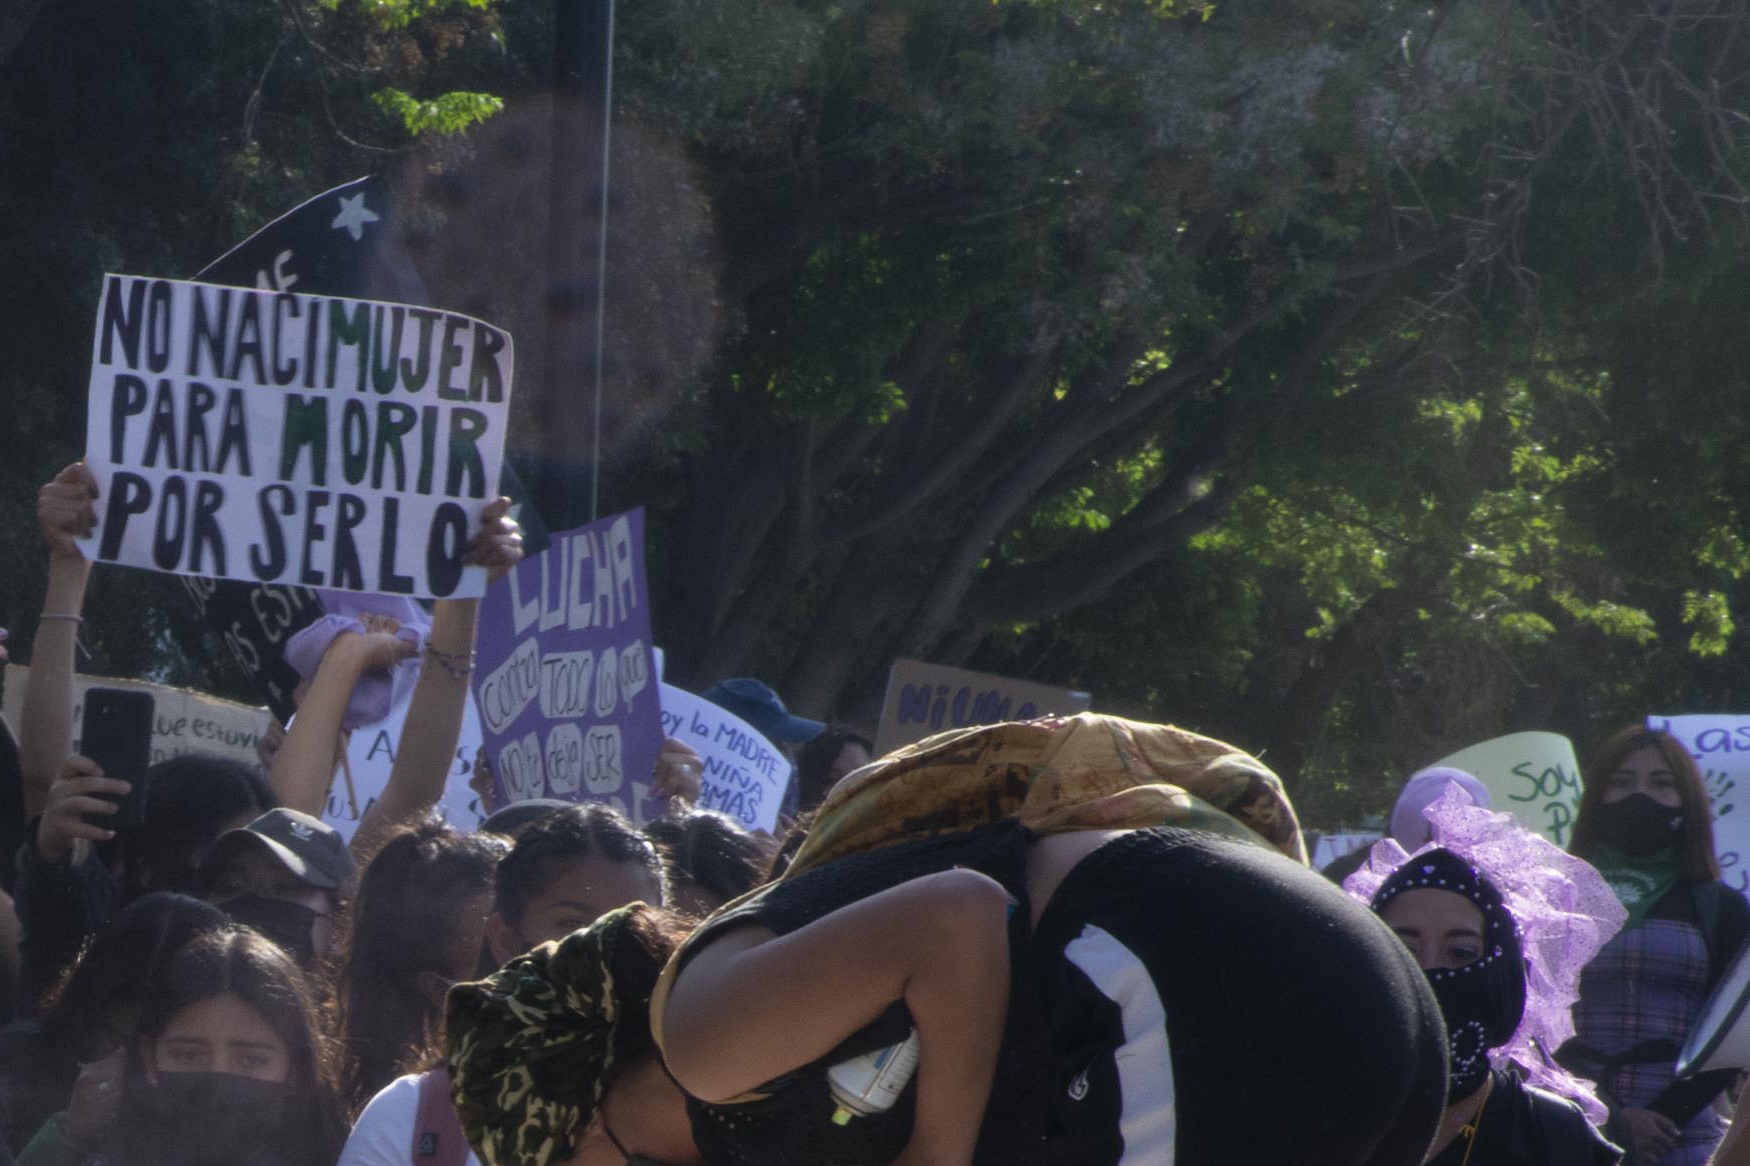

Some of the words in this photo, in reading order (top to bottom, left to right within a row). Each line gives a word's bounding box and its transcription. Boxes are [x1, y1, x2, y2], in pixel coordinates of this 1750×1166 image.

[99, 276, 172, 374] NO
[326, 300, 506, 403] MUJER
[110, 374, 252, 477] PARA
[278, 393, 488, 499] MORIR
[98, 471, 227, 577] POR
[508, 513, 638, 636] LUCHA
